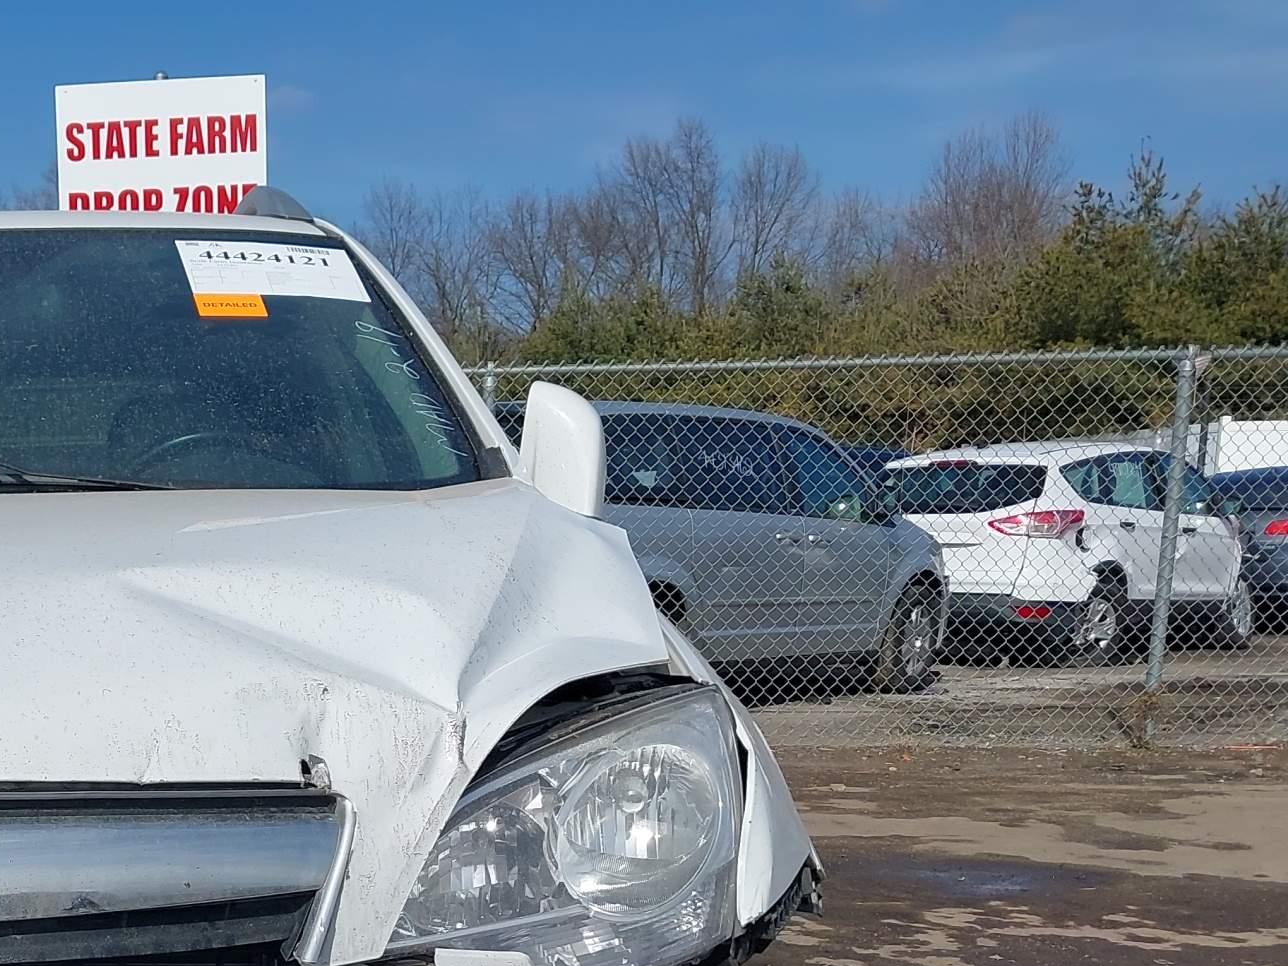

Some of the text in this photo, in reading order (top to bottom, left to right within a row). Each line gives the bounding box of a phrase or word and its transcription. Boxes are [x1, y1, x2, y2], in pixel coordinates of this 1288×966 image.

[65, 114, 258, 162] STATE FARM
[173, 184, 258, 215] ZON
[199, 250, 330, 267] 44424121
